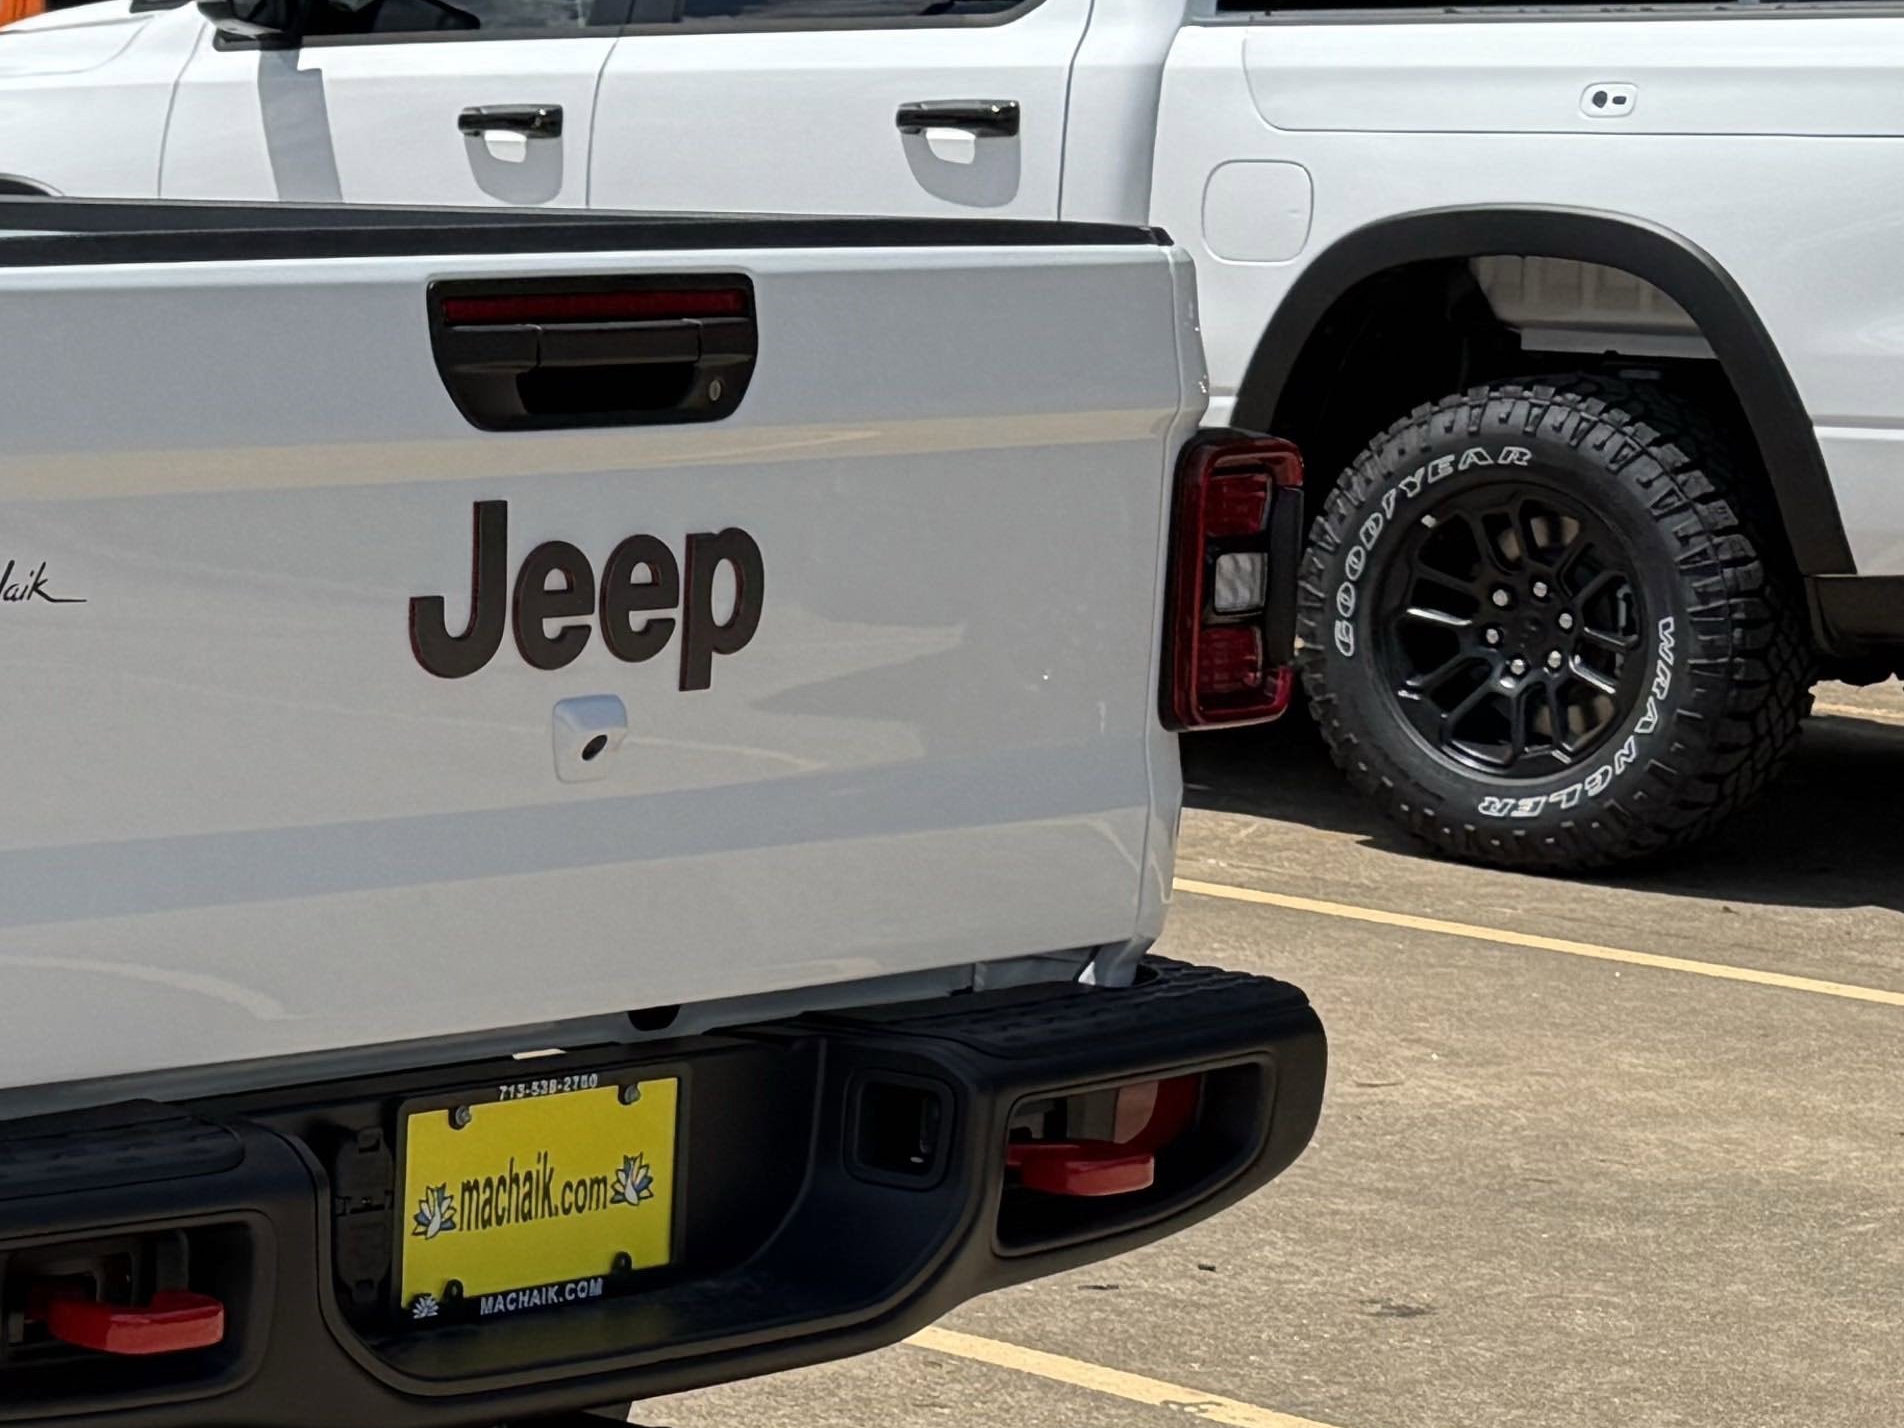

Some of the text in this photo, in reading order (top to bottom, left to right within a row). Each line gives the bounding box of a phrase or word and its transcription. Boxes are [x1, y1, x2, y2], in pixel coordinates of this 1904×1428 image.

[408, 499, 765, 692] Jeep
[1478, 615, 1675, 817] WRANGLER
[457, 1150, 609, 1232] machaik.com
[479, 1277, 604, 1316] MACHAIK.COM
